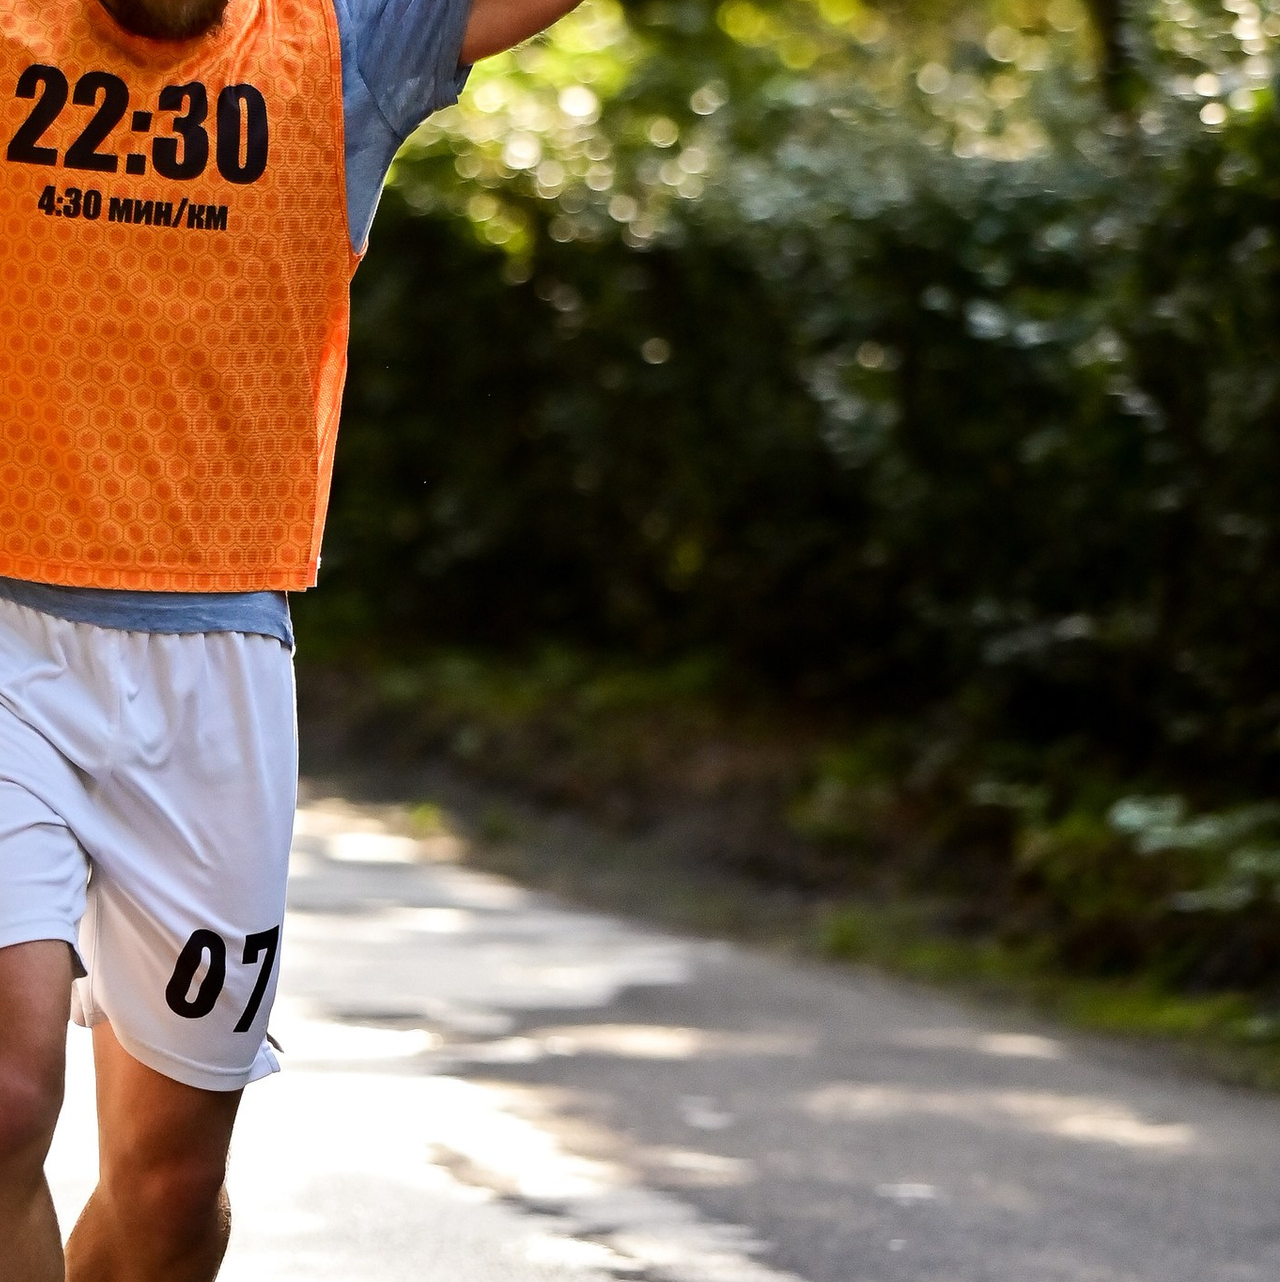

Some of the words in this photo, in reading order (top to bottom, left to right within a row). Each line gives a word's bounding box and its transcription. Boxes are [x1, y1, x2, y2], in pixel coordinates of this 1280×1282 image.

[7, 64, 268, 184] 22:30
[38, 186, 101, 219] 4:30
[166, 924, 279, 1032] 07
